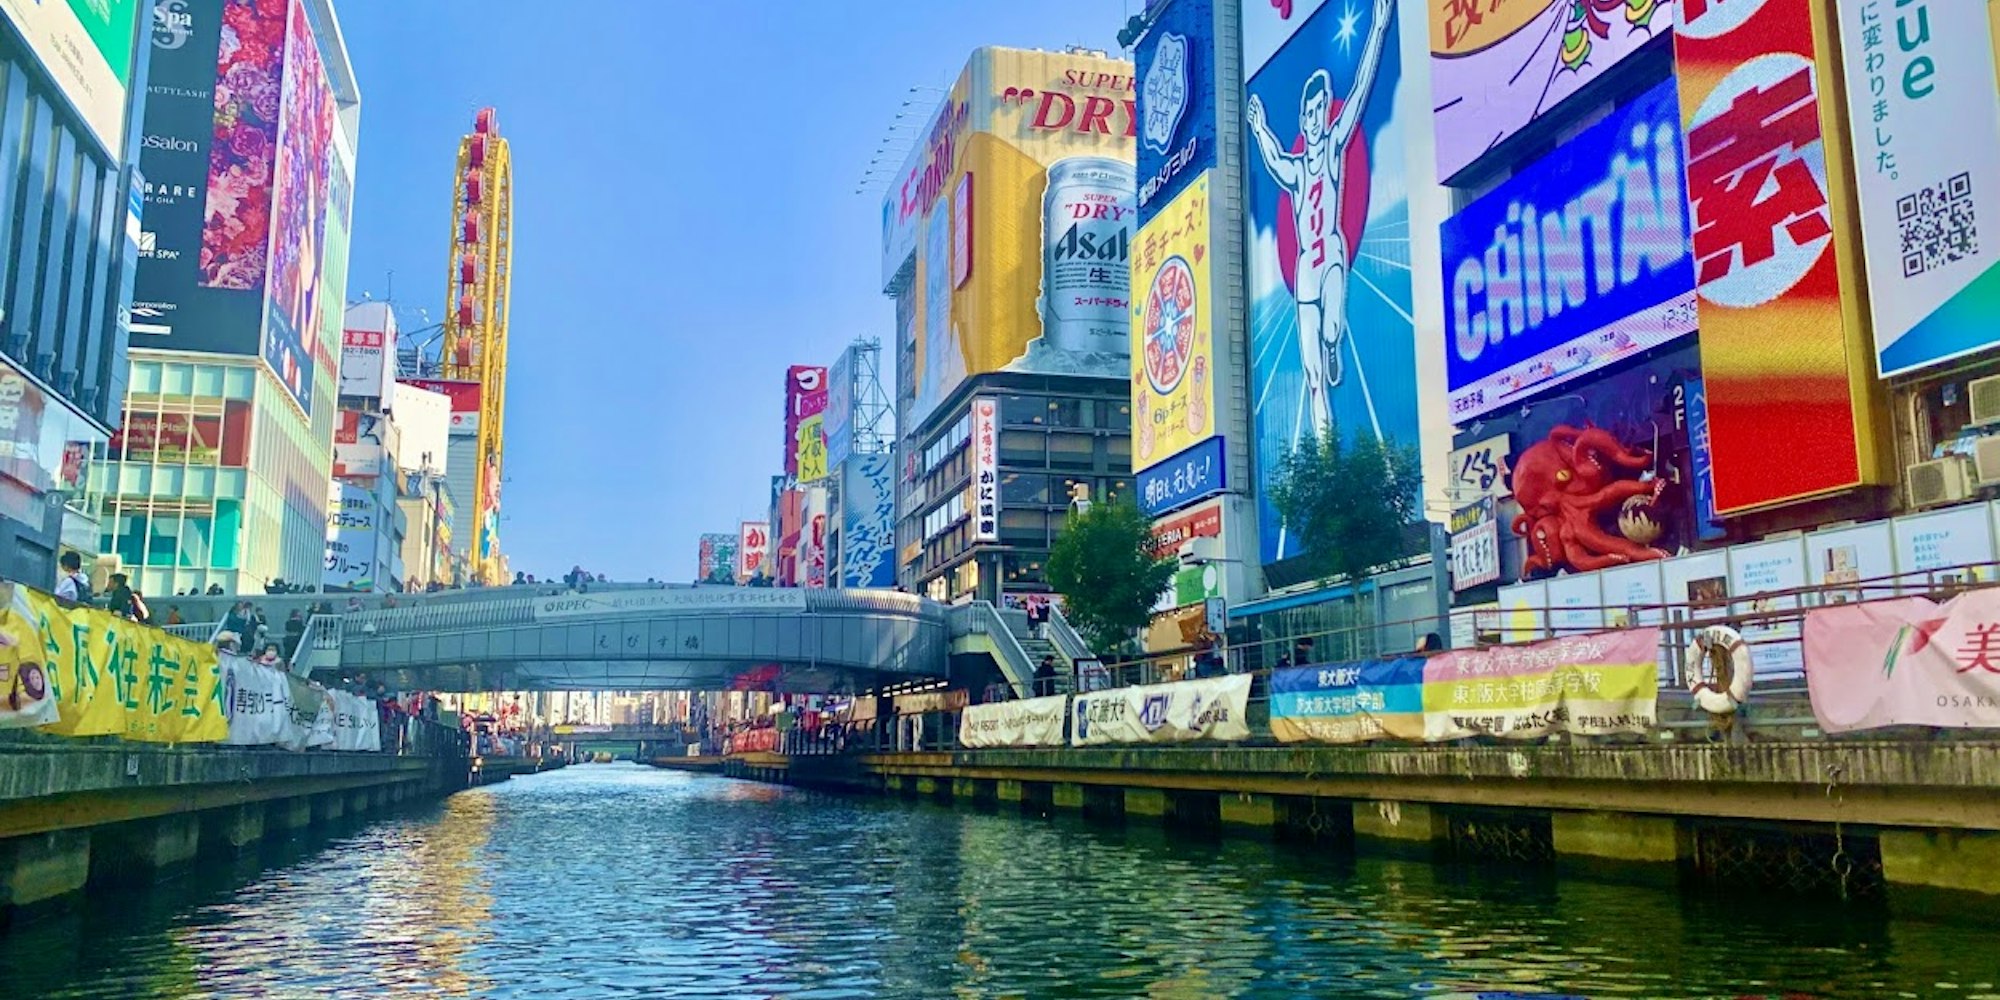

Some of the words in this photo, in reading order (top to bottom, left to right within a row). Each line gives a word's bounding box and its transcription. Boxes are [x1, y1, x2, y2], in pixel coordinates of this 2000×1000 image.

[1895, 0, 1935, 100] ue
[1861, 2, 1898, 180] に変わりました。
[1309, 175, 1327, 268] グリコ
[1089, 267, 1113, 285] 生
[598, 634, 699, 651] えびす橋
[1956, 624, 2000, 674] 美
